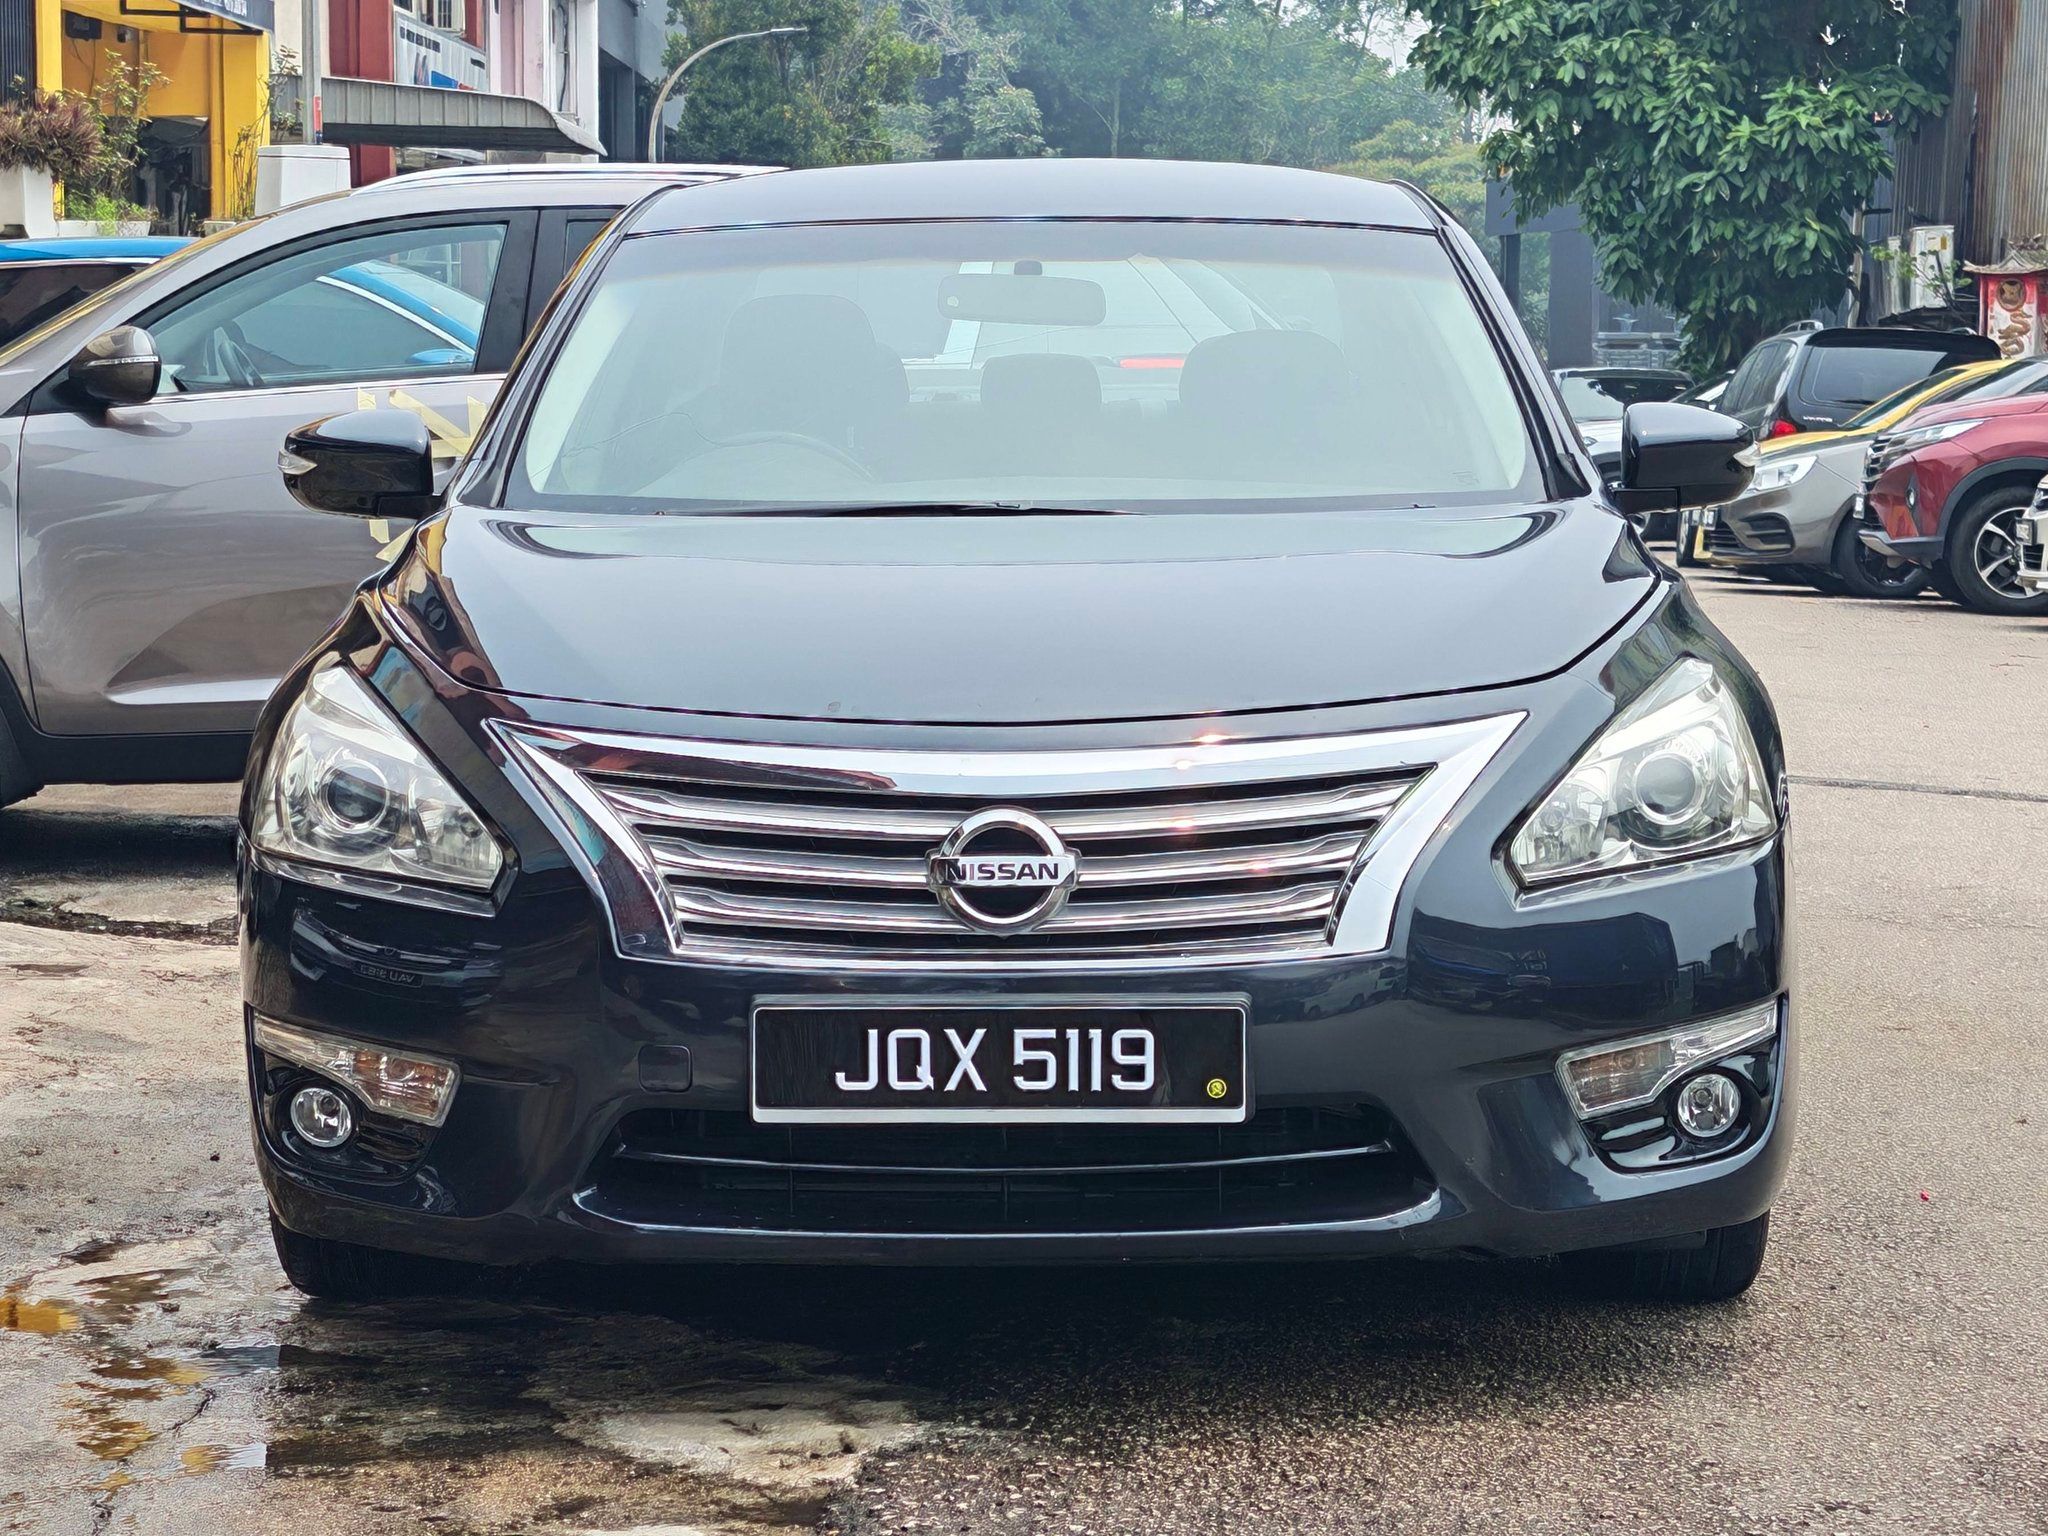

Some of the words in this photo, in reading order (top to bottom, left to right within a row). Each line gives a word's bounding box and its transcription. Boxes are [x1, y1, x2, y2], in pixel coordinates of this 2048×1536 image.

[946, 863, 1059, 881] NISSAN
[835, 1028, 988, 1092] JQX
[1013, 1028, 1155, 1092] 5119
